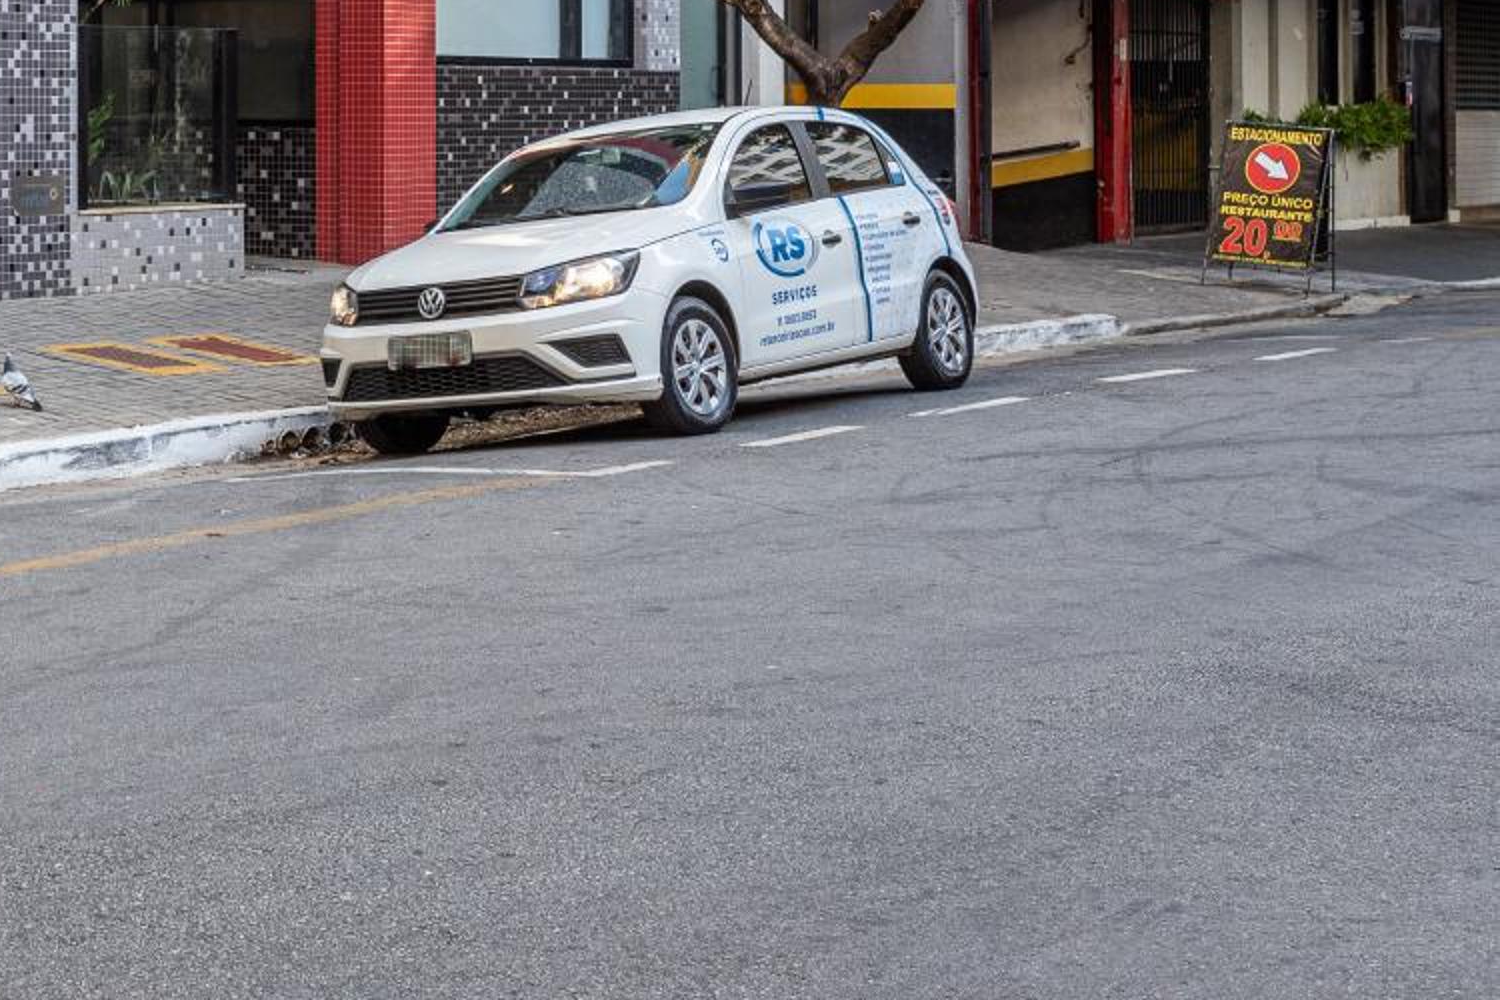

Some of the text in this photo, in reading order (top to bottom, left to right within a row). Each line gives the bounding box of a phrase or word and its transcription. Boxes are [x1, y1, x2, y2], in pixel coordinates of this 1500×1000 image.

[1231, 127, 1323, 145] ESTACIONAMENTO
[1223, 191, 1313, 210] PREÇO ÚNICO
[1221, 205, 1313, 223] RESTAURANTE
[767, 226, 805, 263] RS
